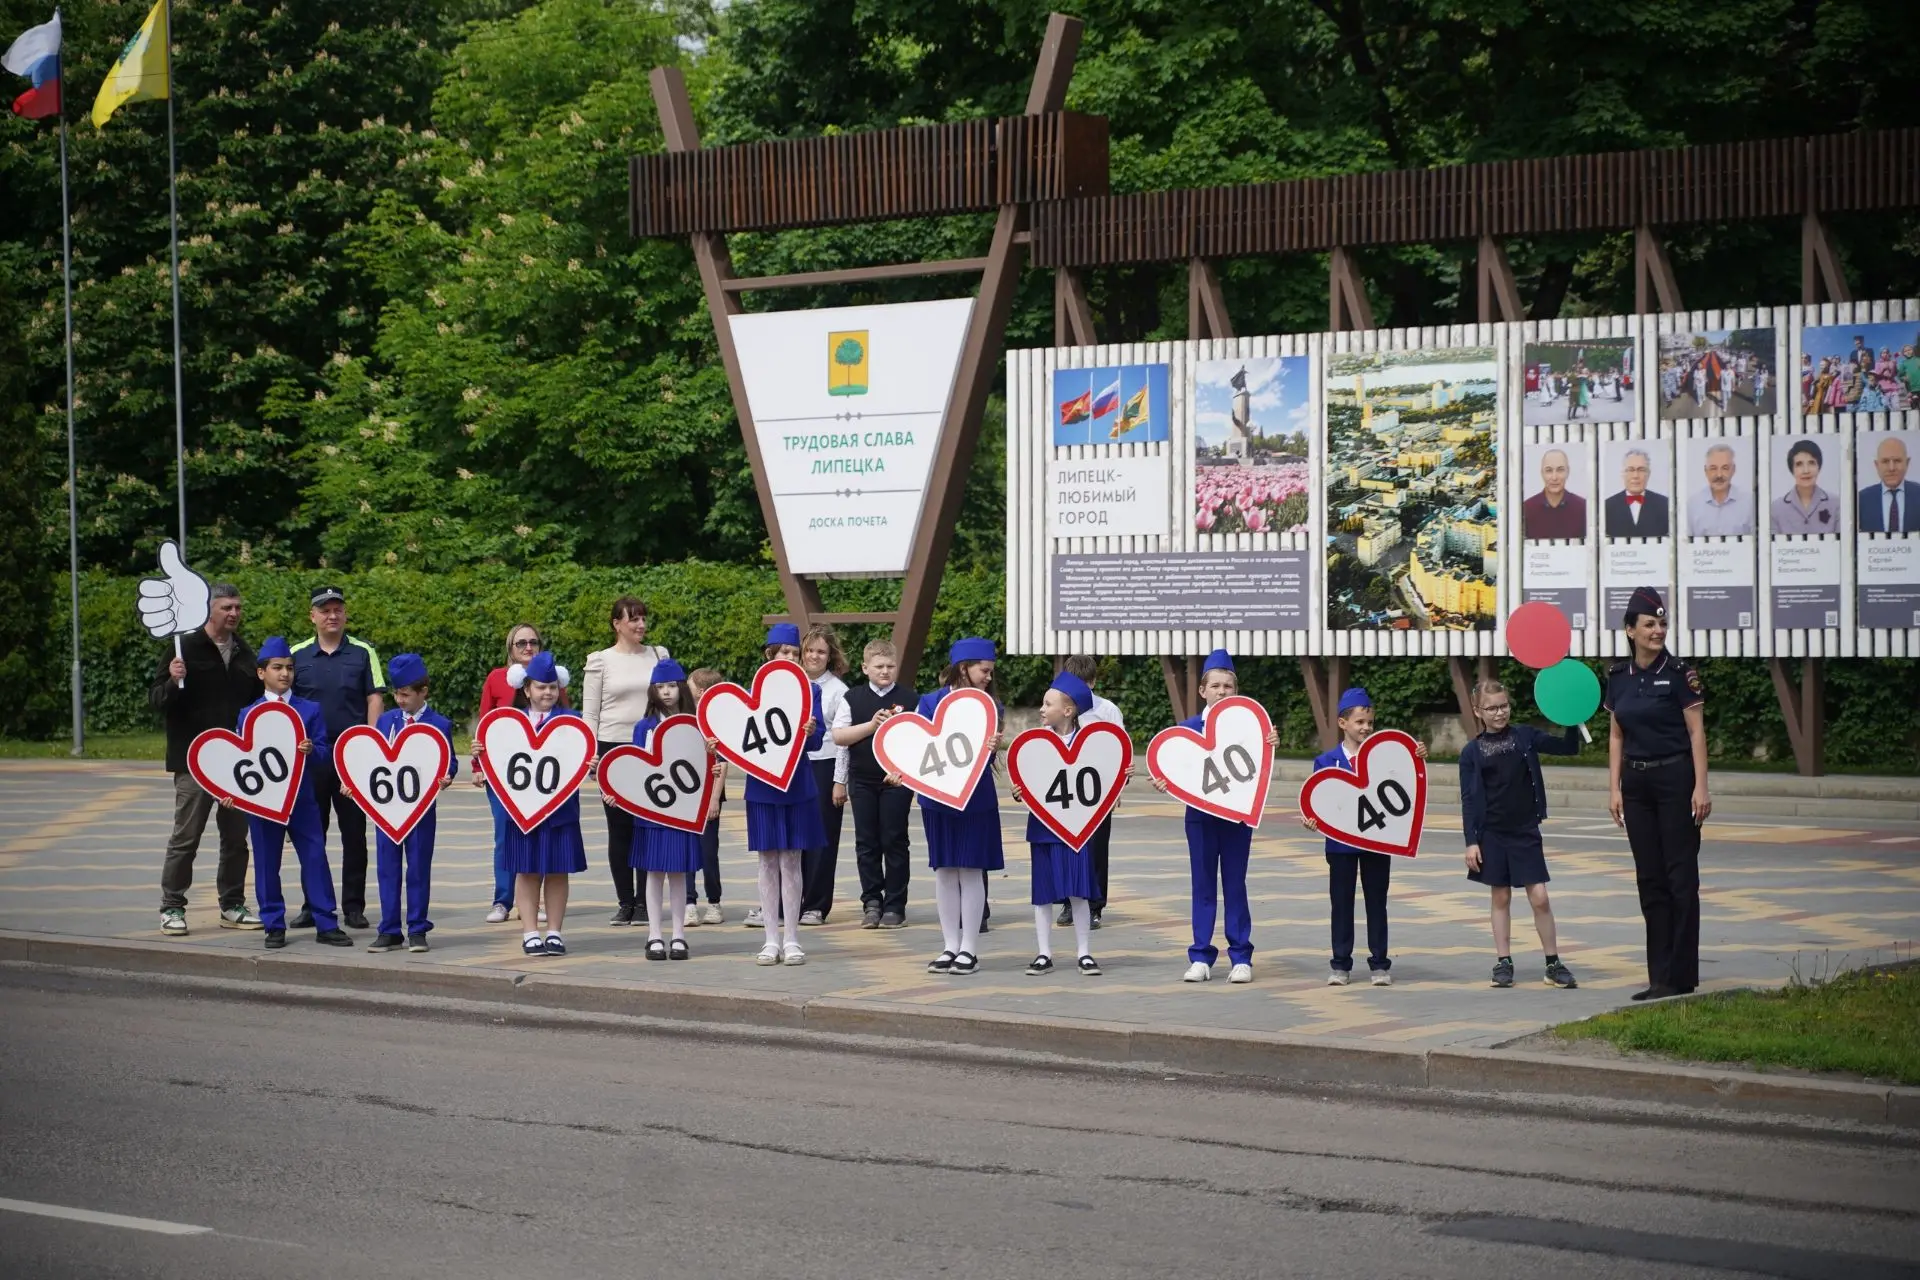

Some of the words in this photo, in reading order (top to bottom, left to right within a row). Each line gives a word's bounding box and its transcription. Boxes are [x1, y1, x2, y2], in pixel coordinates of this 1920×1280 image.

[783, 433, 859, 453] ТРУДОВАЯ
[863, 431, 914, 447] СЛАВА
[810, 457, 885, 477] ЛИПЕЦКА
[1057, 468, 1123, 485] ЛИПЕЦК-
[1057, 485, 1136, 505] ЛЮБИМЫЙ
[808, 517, 845, 529] ДОСКА
[847, 515, 888, 527] ПОЧЕТА
[1058, 510, 1109, 526] ГОРОД
[742, 706, 792, 755] 40
[233, 746, 289, 796] 60
[506, 752, 561, 795] 60
[919, 732, 974, 777] 40
[1201, 744, 1257, 795] 40
[369, 765, 421, 805] 60
[644, 759, 701, 809] 60
[1045, 766, 1102, 810] 40
[1357, 779, 1412, 833] 40
